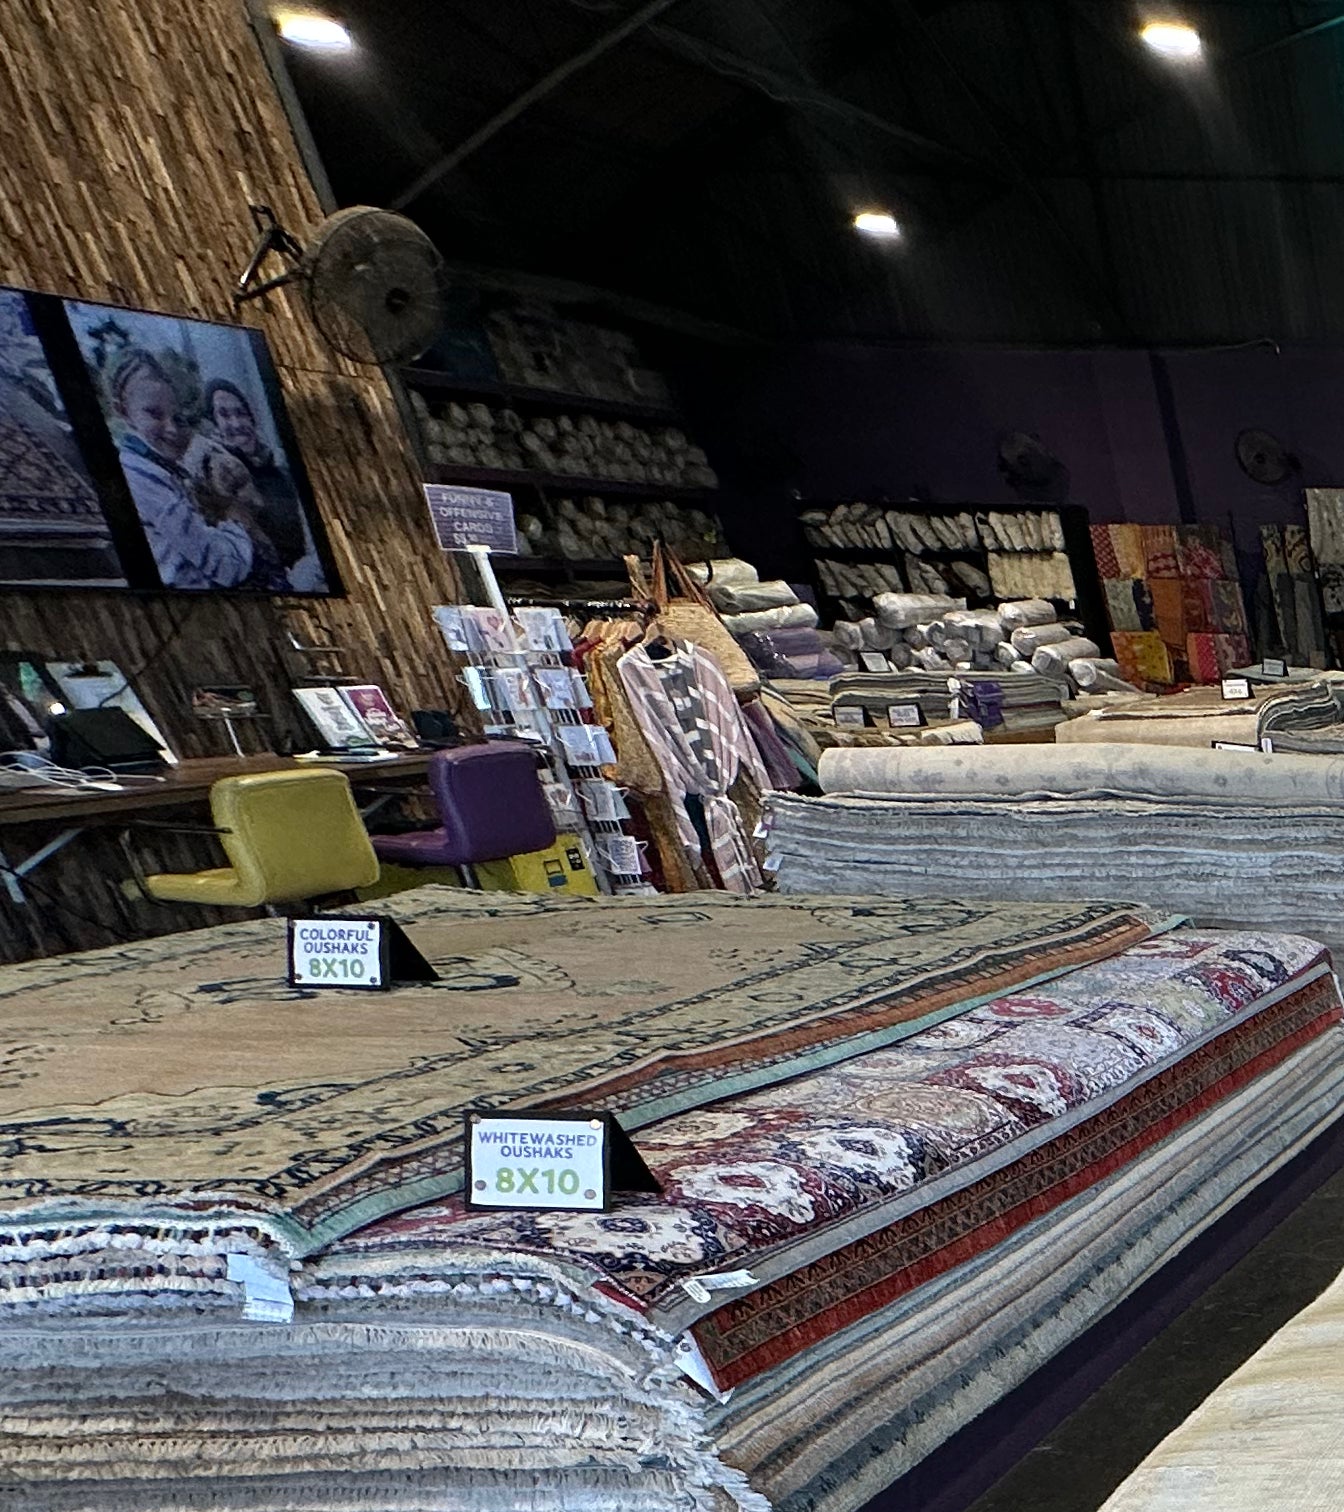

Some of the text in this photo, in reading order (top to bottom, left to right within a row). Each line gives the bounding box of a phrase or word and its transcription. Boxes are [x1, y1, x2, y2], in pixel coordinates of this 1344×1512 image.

[300, 928, 374, 941] COLORFUL
[303, 941, 368, 955] OUSHAKS
[308, 957, 366, 979] 8X10
[478, 1131, 598, 1147] WHITEWASHED
[500, 1145, 574, 1159] OUSHAKS
[495, 1166, 580, 1195] 8X10
